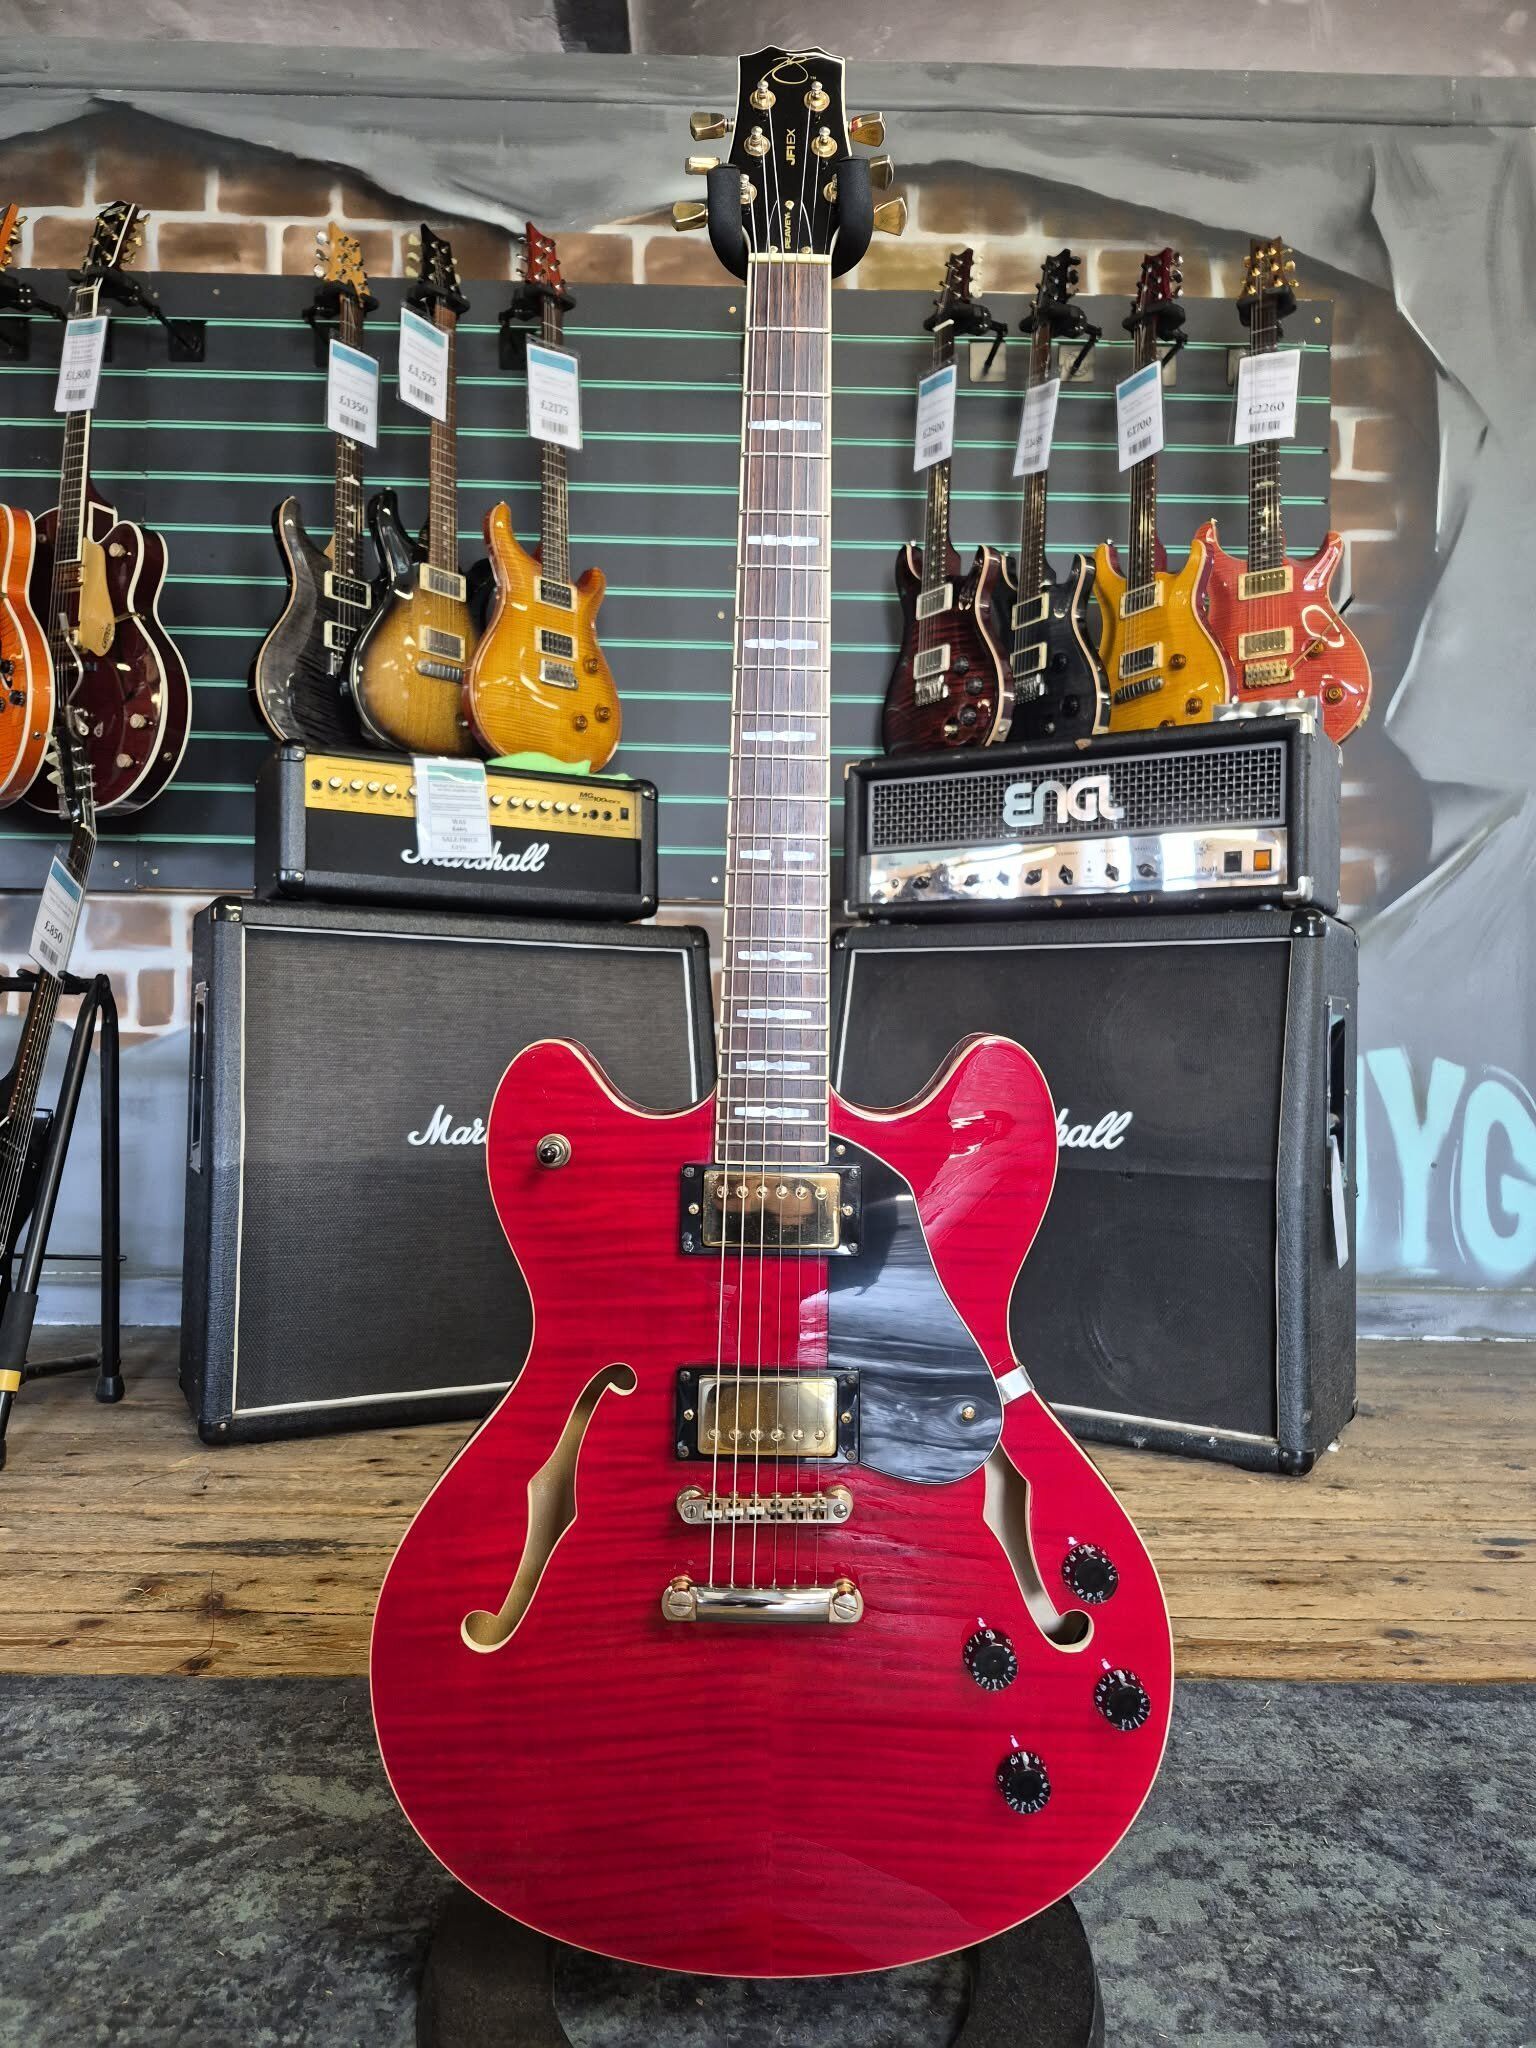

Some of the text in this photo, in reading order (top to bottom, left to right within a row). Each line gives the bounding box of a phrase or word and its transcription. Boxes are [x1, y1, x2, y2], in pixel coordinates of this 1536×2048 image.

[784, 212, 792, 249] PEAVEY
[339, 395, 369, 415] £1350
[541, 400, 569, 416] £2175
[1248, 401, 1286, 416] £2260
[1003, 774, 1125, 827] ENGL
[45, 920, 63, 944] £850
[407, 1104, 487, 1146] Mar
[1357, 1047, 1536, 1275] YG
